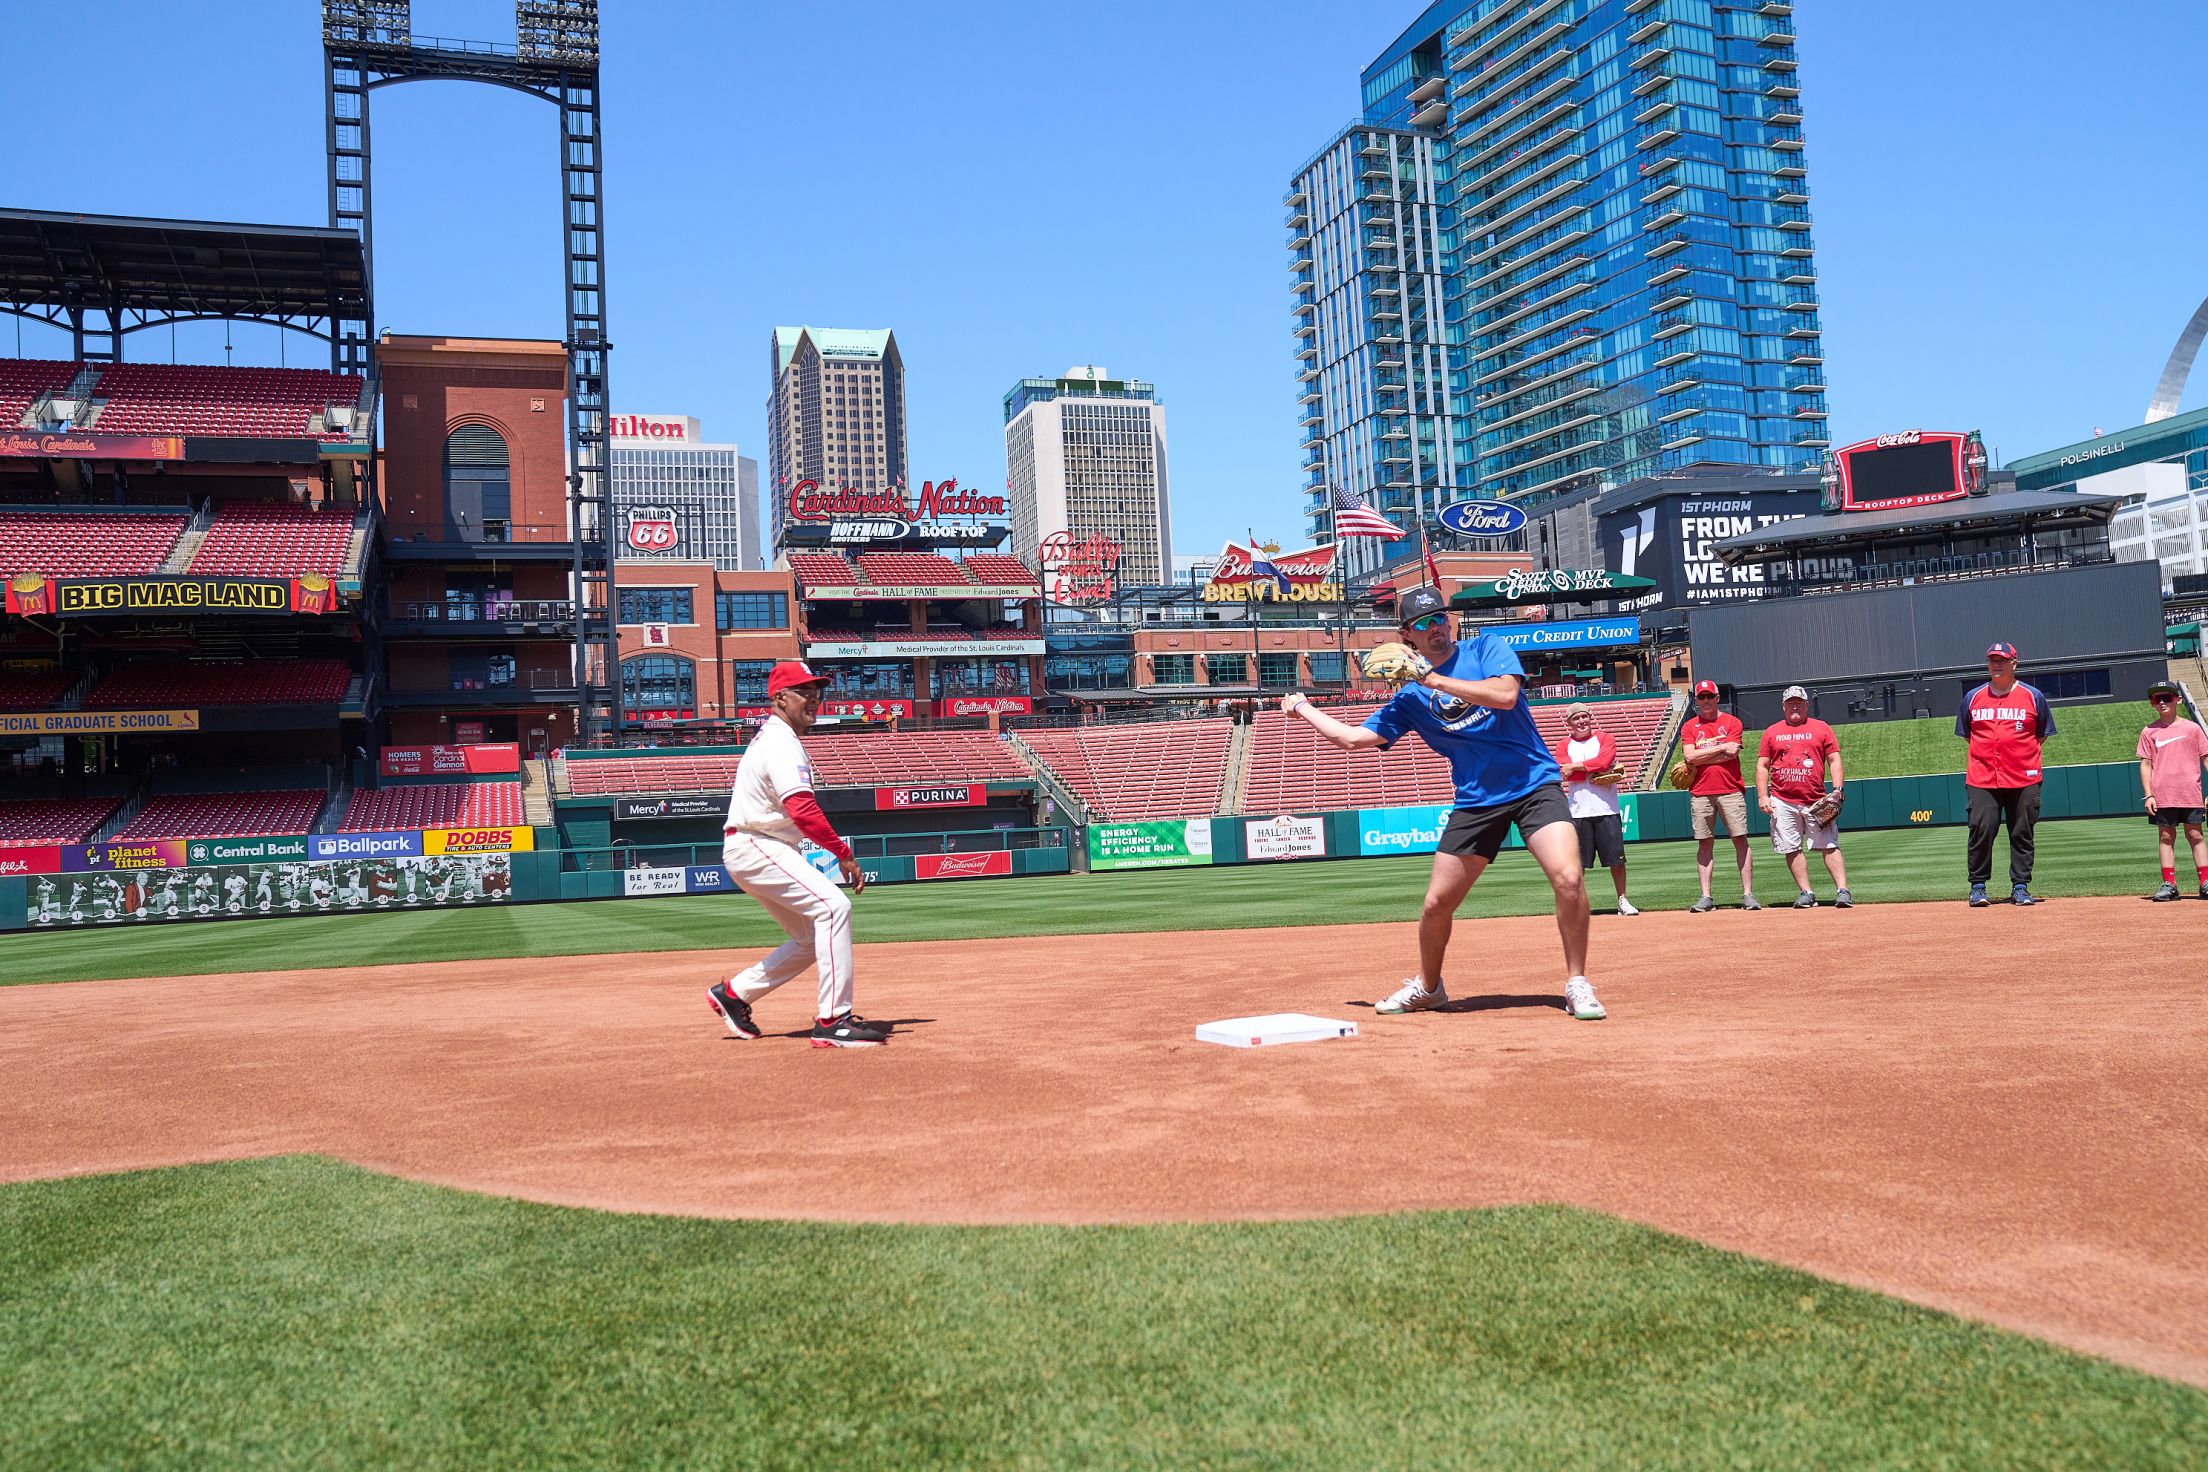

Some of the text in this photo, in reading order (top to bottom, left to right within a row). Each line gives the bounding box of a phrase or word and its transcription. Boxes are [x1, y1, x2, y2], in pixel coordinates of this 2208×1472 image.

[9, 434, 39, 453] Louis
[41, 435, 97, 453] Cardinals
[2061, 442, 2125, 467] POLSINELLI
[789, 480, 1005, 522] Cardinals Nation
[1681, 500, 1752, 513] 1ST PHORM
[1865, 494, 1944, 509] ROOFTOP DECK
[633, 510, 671, 521] PHILLIPS
[1458, 504, 1510, 529] Ford
[636, 525, 669, 544] 66
[830, 522, 896, 537] HOFFMANN
[919, 526, 988, 538] ROOFTOP
[1682, 517, 1752, 539] FROM
[1038, 531, 1121, 571] Bally
[1683, 540, 1722, 561] LO
[1057, 564, 1102, 577] SPORTS
[1210, 554, 1336, 578] Bueiser
[1507, 568, 1549, 581] SCOTT
[1574, 569, 1605, 579] MVP
[853, 588, 879, 596] Cardinals
[882, 587, 906, 596] HALL
[907, 588, 913, 596] of
[914, 586, 938, 596] FAME
[998, 587, 1019, 595] Jones
[1054, 577, 1112, 605] Live!
[1495, 577, 1544, 593] CREDIT
[1575, 579, 1613, 590] DECK
[61, 582, 285, 611] BIG MAC LAND
[1204, 583, 1266, 602] BREW
[1507, 584, 1551, 600] UNION
[1618, 600, 1631, 612] 1ST
[1500, 627, 1633, 645] OTT CREDIT UNION
[838, 647, 863, 656] Mercy
[923, 645, 949, 653] Provider
[969, 644, 978, 652] St.
[979, 644, 995, 652] Louis
[996, 643, 1025, 652] Cardinals
[954, 699, 1024, 715] Cardinals Nation
[45, 715, 116, 730] GRADUATE
[120, 714, 173, 728] SCHOOL
[433, 754, 465, 762] Cardinal
[911, 789, 964, 802] PURINA
[629, 805, 660, 815] Mercy
[1910, 810, 1933, 822] 400'
[447, 830, 512, 846] DOBBS
[1100, 828, 1139, 837] ENERGY
[1258, 829, 1281, 838] HALL
[1289, 826, 1313, 836] FAME
[338, 836, 411, 853] Ballpark
[1101, 836, 1158, 846] EFFICIENCY
[108, 845, 157, 860] planet
[213, 841, 305, 859] Central Bank
[1102, 847, 1111, 855] IS
[1122, 845, 1151, 854] HOME
[1153, 843, 1174, 852] RUN
[1260, 844, 1312, 853] Edward Jones
[90, 855, 100, 864] pf
[115, 855, 167, 869] fitness
[941, 857, 986, 870] Budweiser
[648, 872, 680, 880] READY
[864, 871, 878, 882] 75'
[632, 881, 678, 891] for Real
